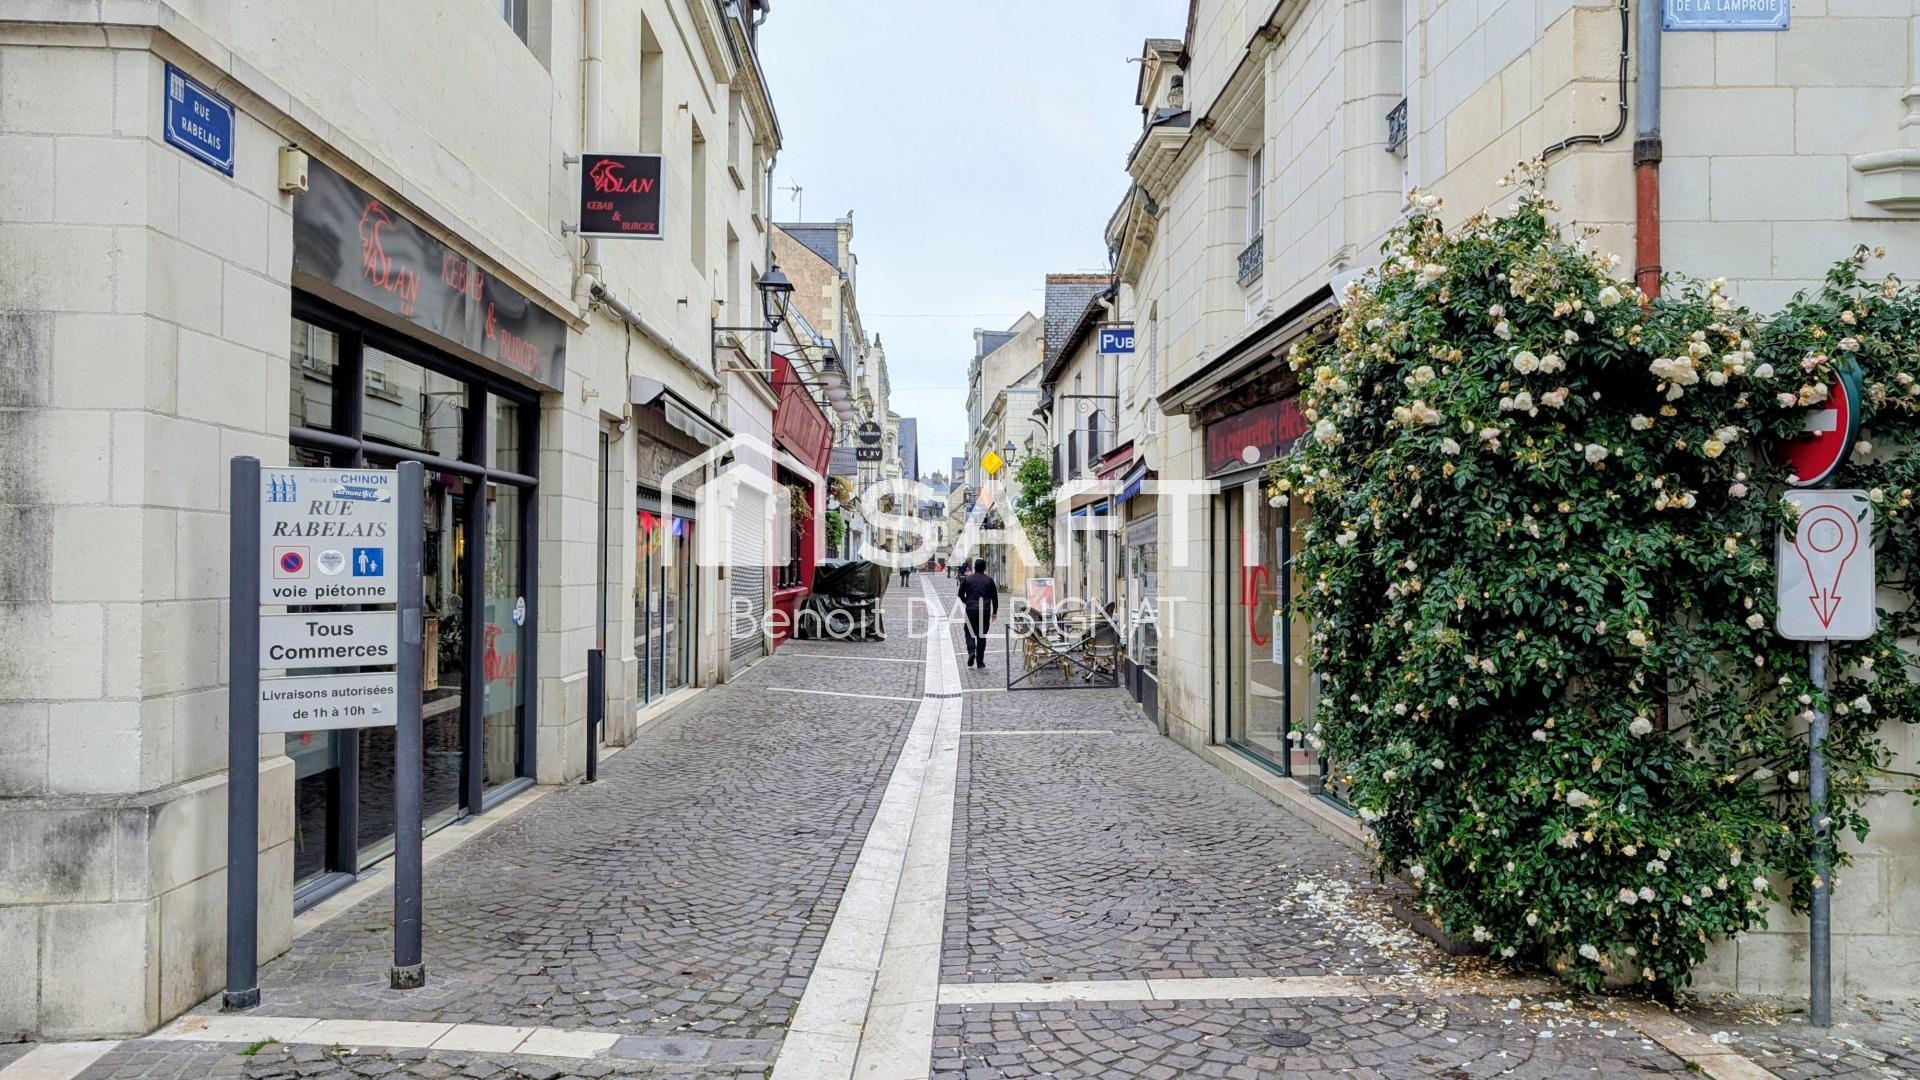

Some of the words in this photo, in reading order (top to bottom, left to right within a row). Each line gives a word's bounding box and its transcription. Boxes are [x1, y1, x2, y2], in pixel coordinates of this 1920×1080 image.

[1676, 0, 1691, 11] DE
[1697, 0, 1711, 11] LA
[1717, 0, 1777, 11] LAMPROIE
[193, 100, 211, 121] RUE
[181, 116, 221, 151] RABELAIS
[586, 201, 614, 210] KEBAB
[612, 210, 622, 221] &
[622, 222, 656, 231] BURGER
[441, 251, 484, 302] KEBAB
[485, 302, 497, 341] &
[501, 328, 541, 374] BURGER
[340, 474, 388, 485] CHINON
[308, 500, 354, 516] RUE
[272, 521, 388, 537] RABELAIS
[273, 585, 308, 598] voie
[315, 584, 386, 600] piétonne
[305, 622, 354, 637] Tous
[269, 644, 388, 661] Commerces
[262, 690, 328, 701] Livraisons
[331, 684, 394, 698] autorisées
[292, 709, 309, 719] de
[313, 707, 328, 718] 1h
[331, 706, 339, 717] à
[343, 705, 365, 717] 10h
